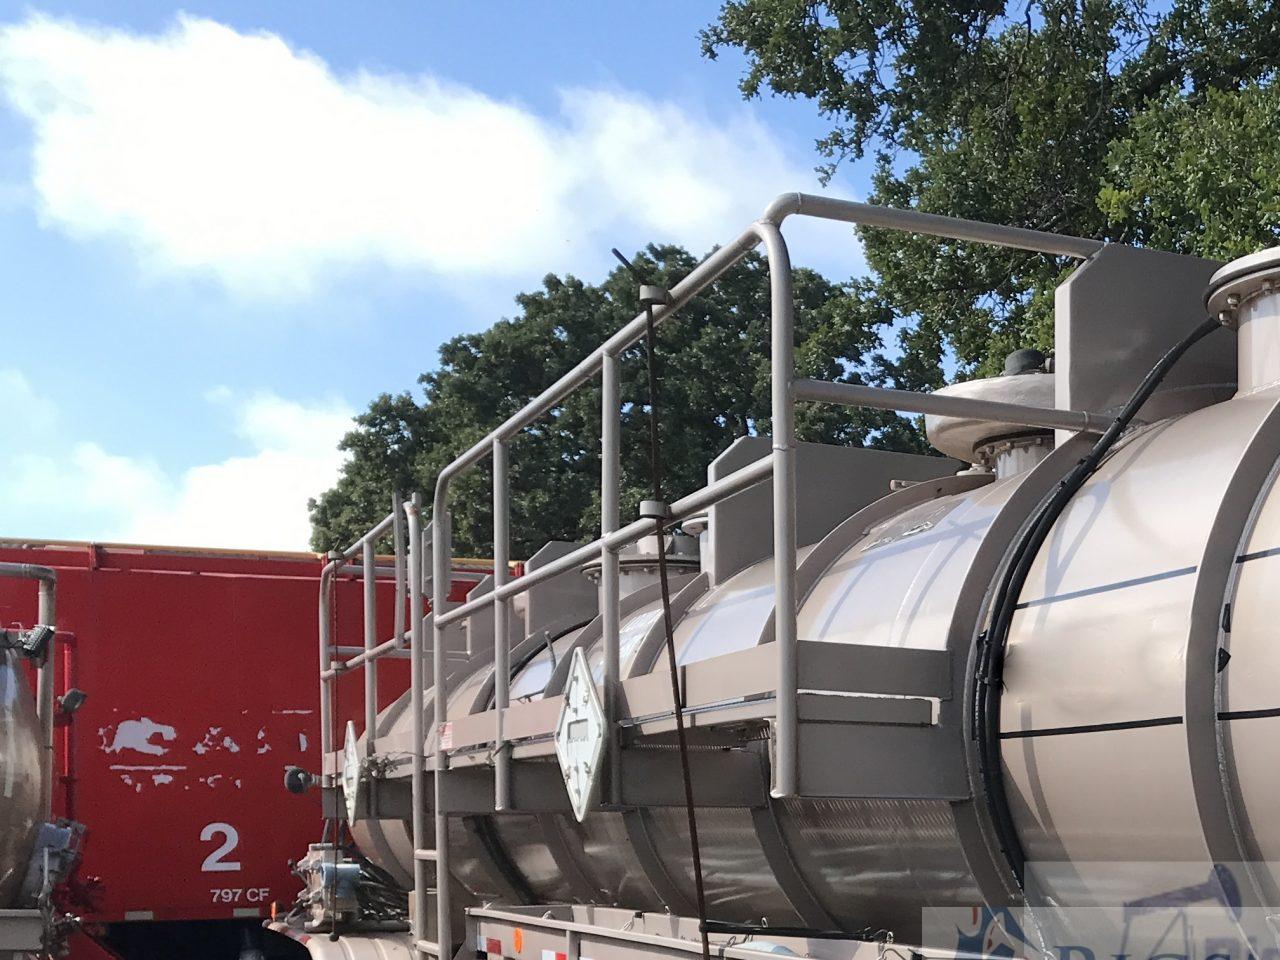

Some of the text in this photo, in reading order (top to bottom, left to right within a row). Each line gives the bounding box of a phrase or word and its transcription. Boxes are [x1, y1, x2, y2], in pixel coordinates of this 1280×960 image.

[200, 822, 241, 872] 2
[210, 887, 270, 904] 797 CF
